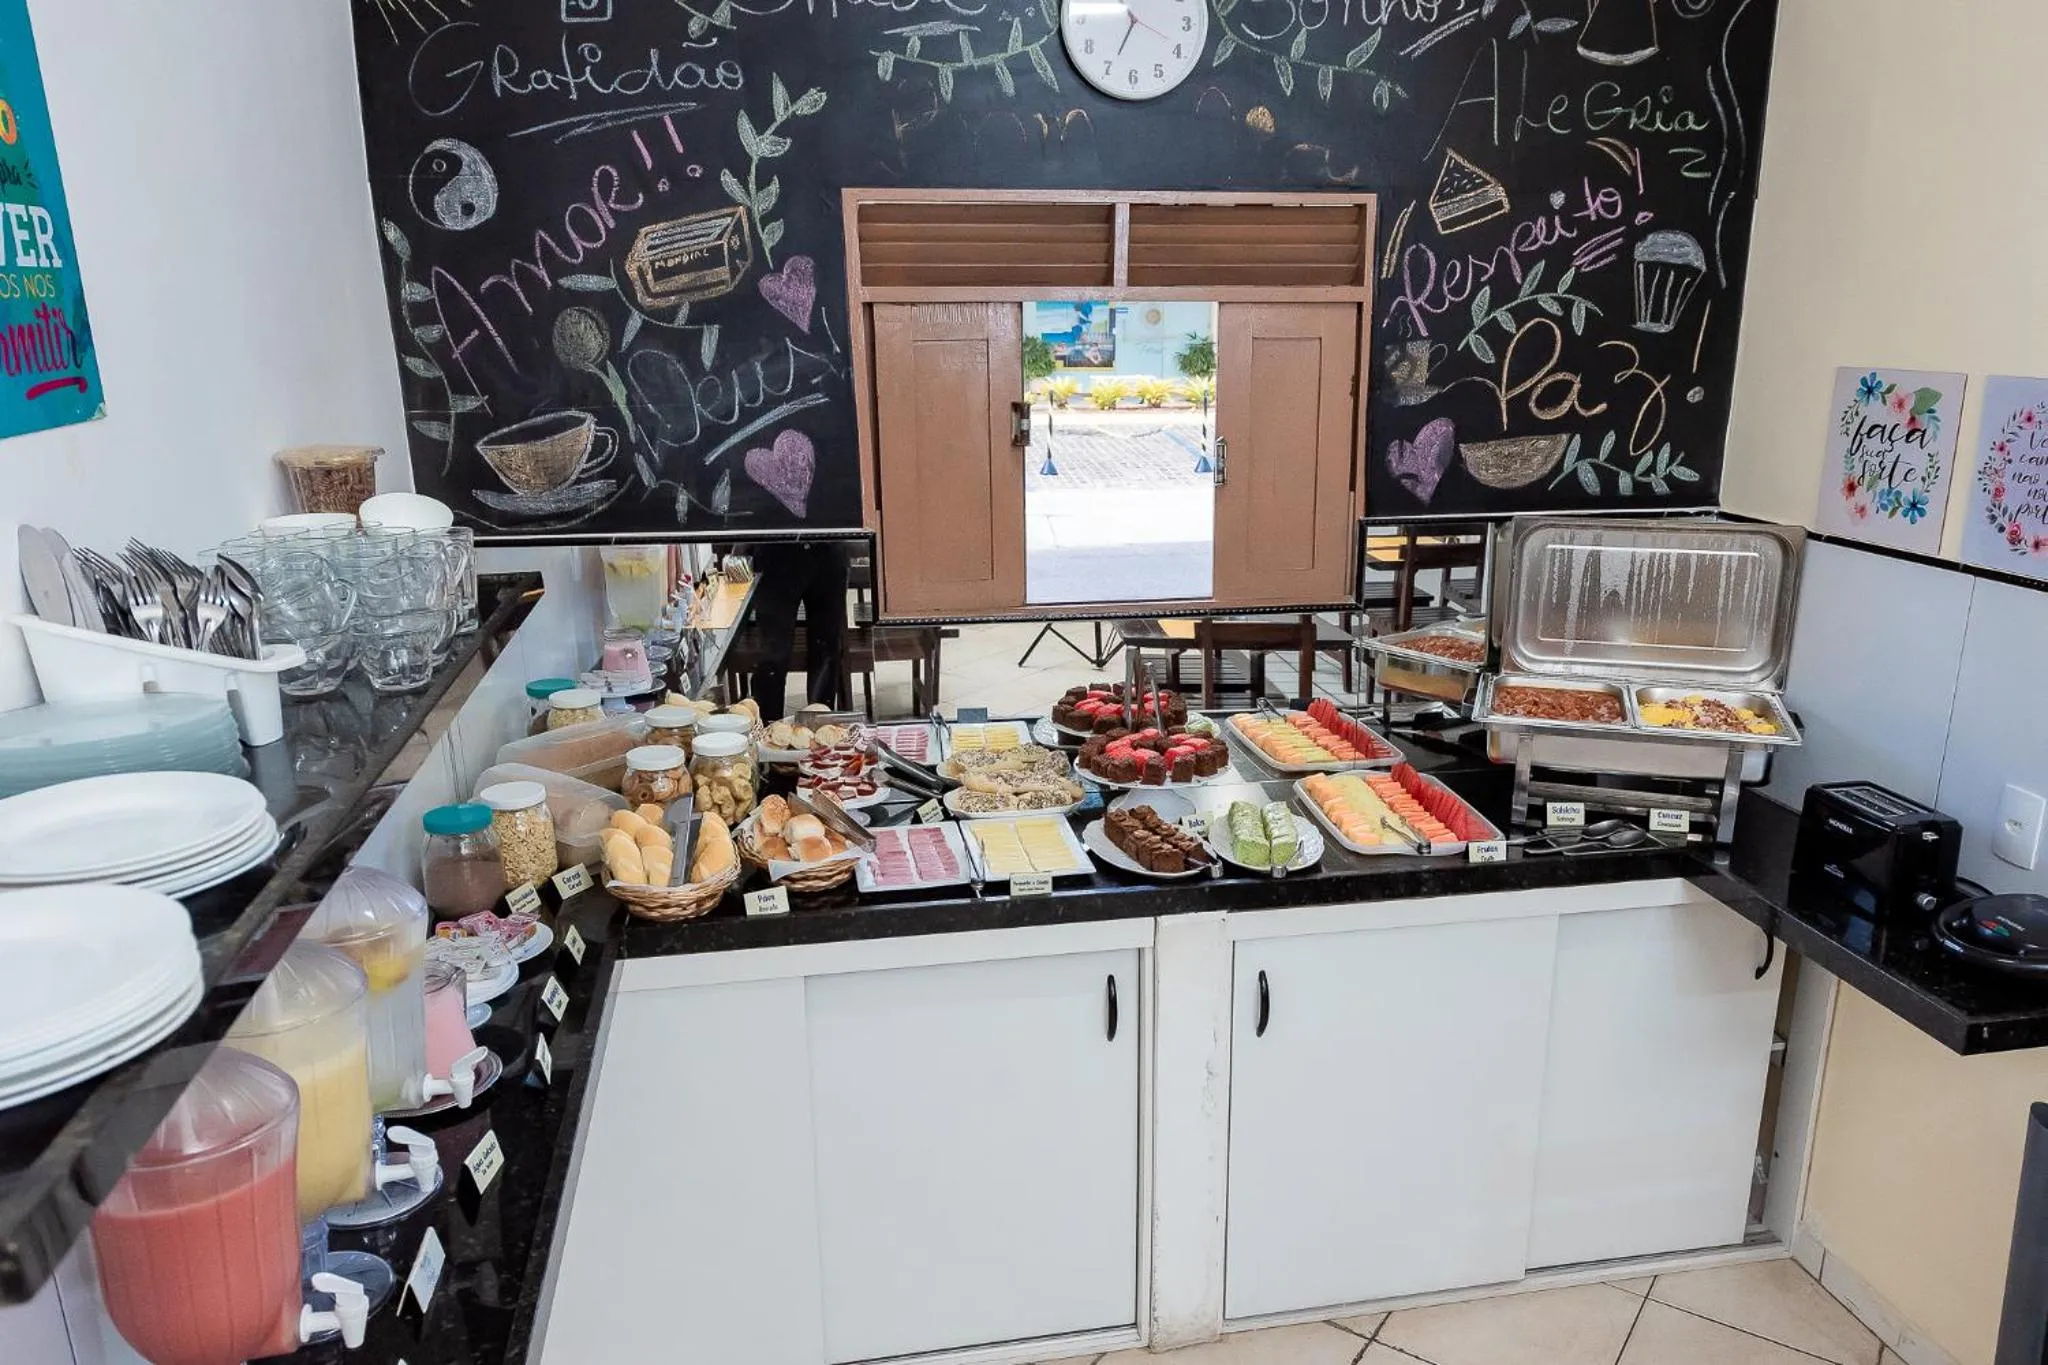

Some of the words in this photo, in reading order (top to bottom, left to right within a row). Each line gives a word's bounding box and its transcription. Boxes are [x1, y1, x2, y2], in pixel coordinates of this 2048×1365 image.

[1181, 15, 1192, 32] 3
[1084, 38, 1095, 54] 8
[1172, 43, 1182, 59] 4
[1103, 60, 1113, 76] 7
[1154, 63, 1164, 79] 5
[1128, 69, 1138, 85] 6
[23, 275, 56, 299] NOS
[1443, 300, 1711, 456] Paz!
[1850, 415, 1932, 456] faça
